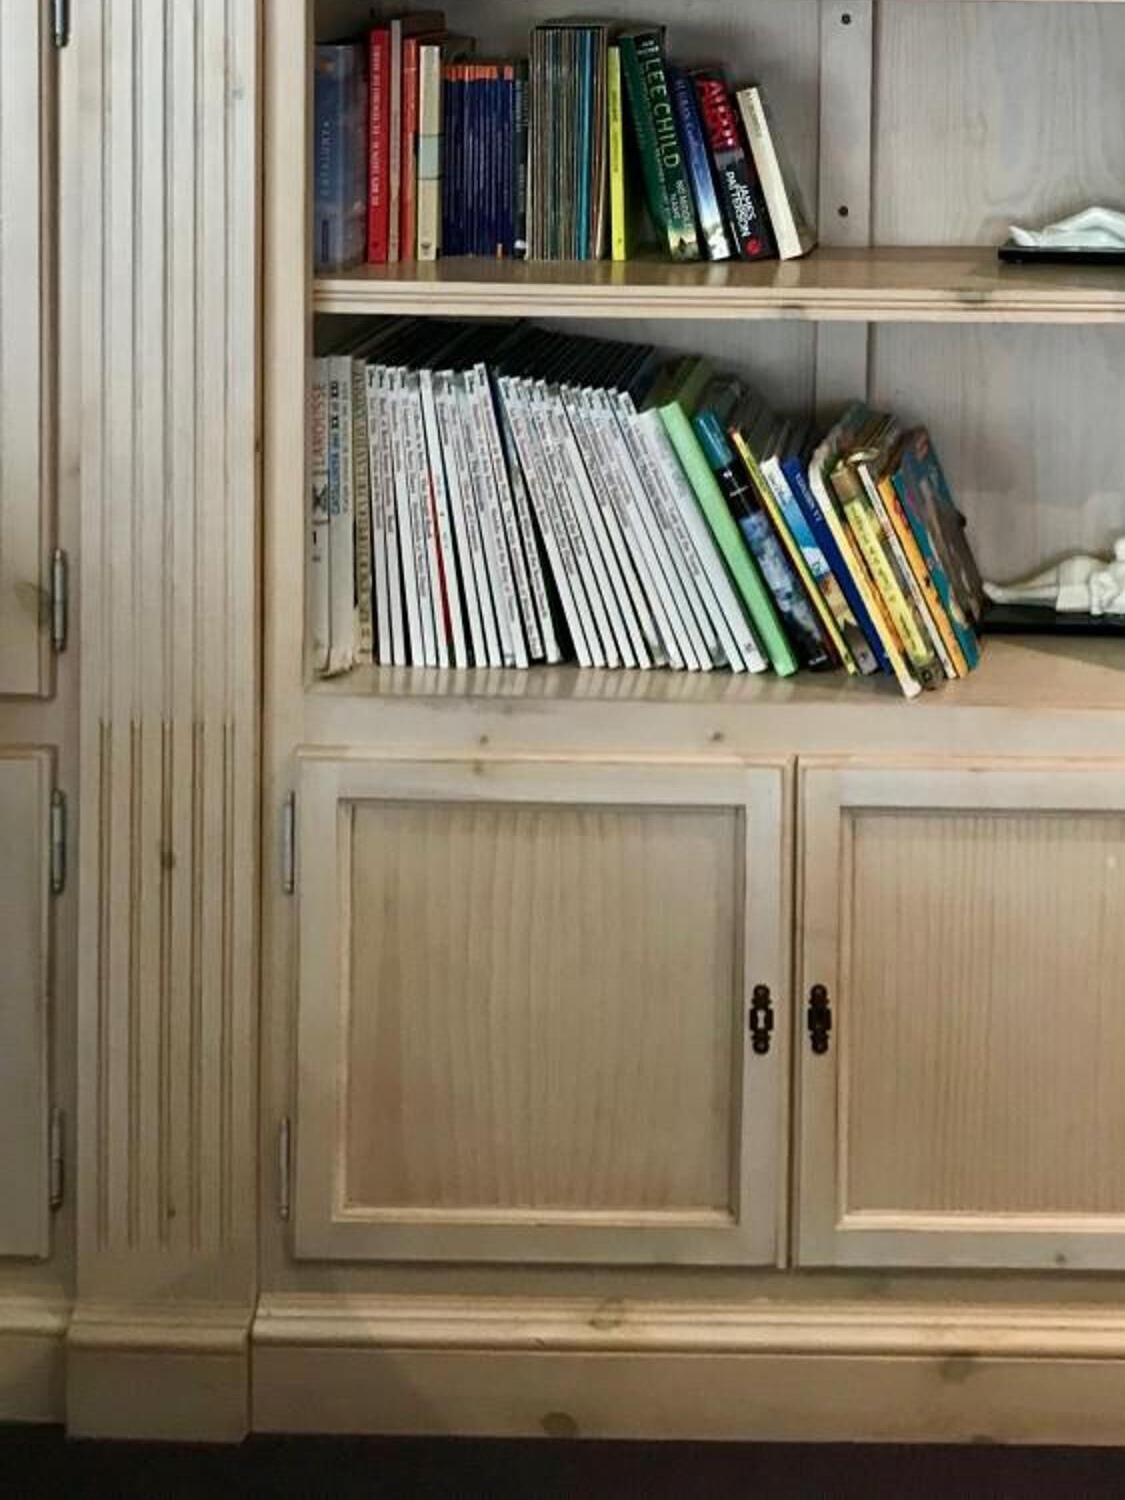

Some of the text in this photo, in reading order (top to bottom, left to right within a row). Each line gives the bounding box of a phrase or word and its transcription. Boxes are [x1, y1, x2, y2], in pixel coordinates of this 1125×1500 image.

[643, 57, 667, 99] LEE
[652, 101, 682, 168] CHILD
[725, 170, 752, 237] PATTERSON
[738, 183, 757, 221] JAMES
